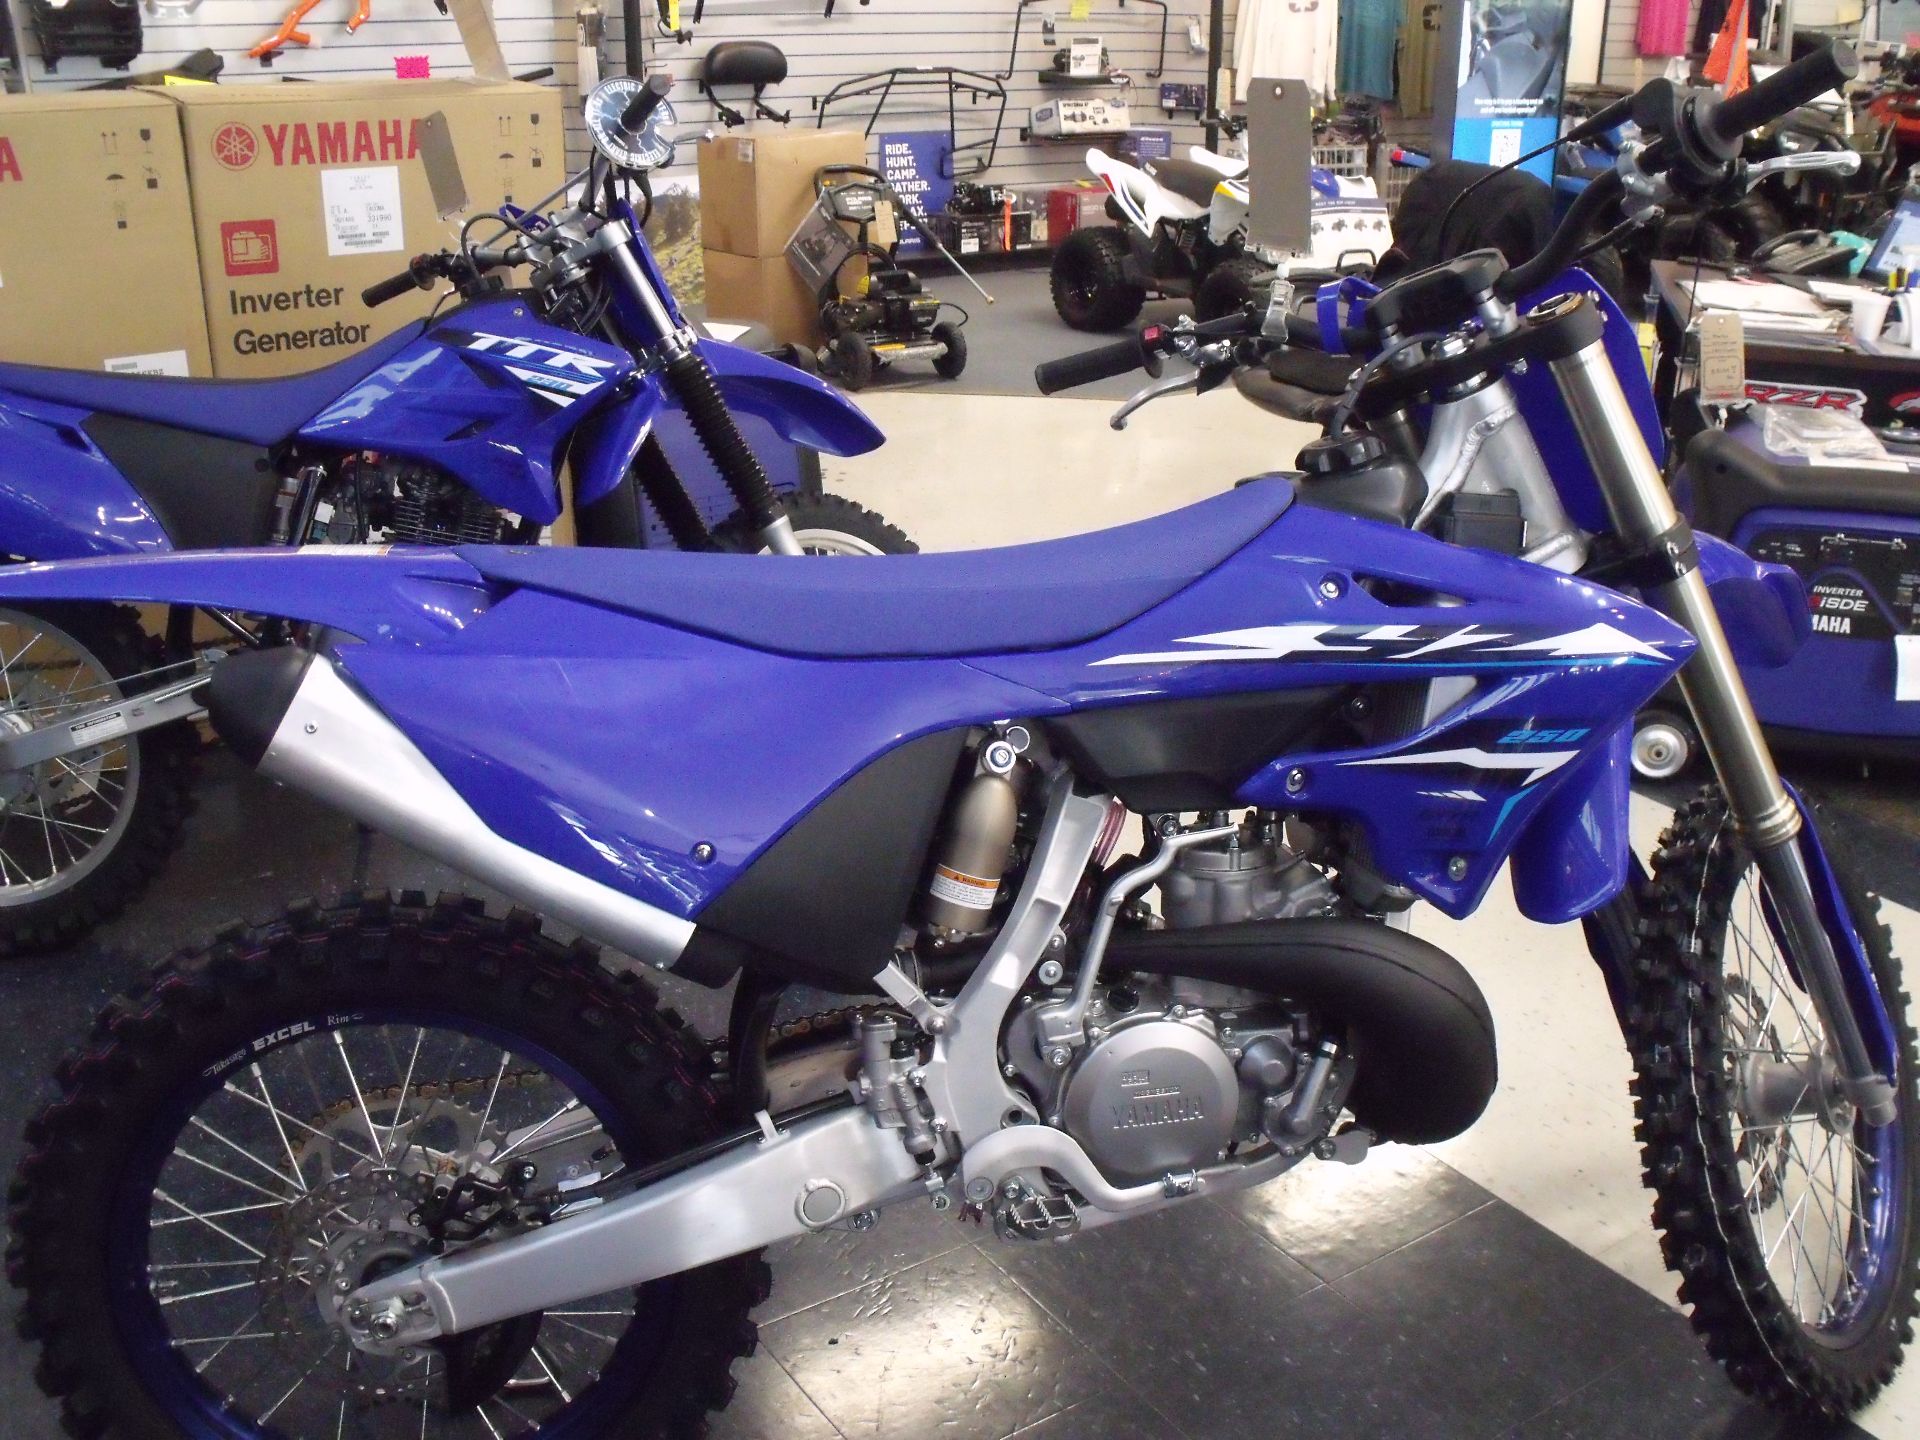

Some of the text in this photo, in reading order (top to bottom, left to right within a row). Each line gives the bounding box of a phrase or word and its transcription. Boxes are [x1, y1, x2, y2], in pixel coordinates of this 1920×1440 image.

[604, 81, 635, 95] ELECTRIC
[885, 143, 912, 155] RIDE.
[886, 156, 917, 168] HUNT.
[887, 169, 919, 180] CAMP.
[229, 284, 344, 315] Inverter
[233, 321, 370, 355] Generator
[1813, 585, 1864, 597] INVERTER
[1496, 728, 1592, 744] 250
[252, 1021, 316, 1051] EXCEL
[327, 1013, 350, 1026] Rim
[1112, 1096, 1205, 1129] YAMAHA
